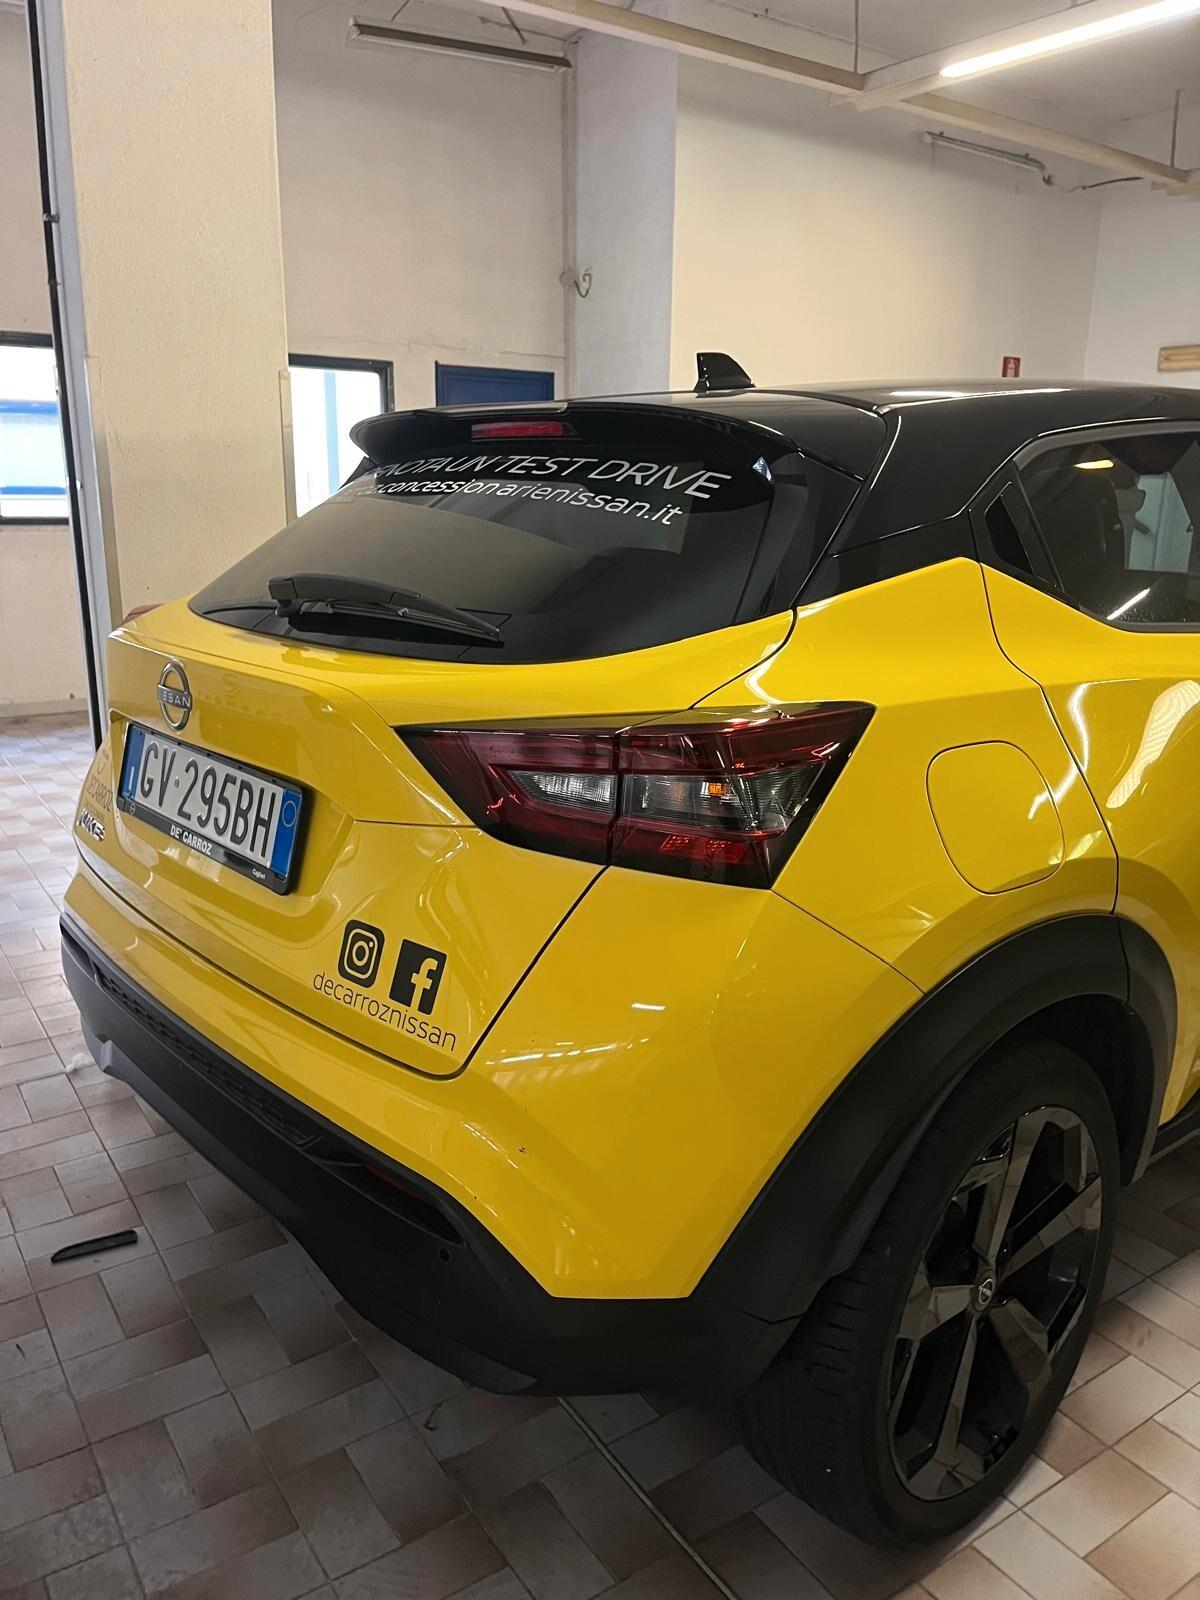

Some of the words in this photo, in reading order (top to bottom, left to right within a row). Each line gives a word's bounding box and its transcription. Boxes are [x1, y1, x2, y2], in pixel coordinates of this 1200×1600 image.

[445, 455, 502, 472] UN
[494, 455, 599, 475] TEST
[587, 460, 732, 499] DRIVE
[140, 742, 176, 807] GV
[177, 759, 276, 858] 295BH
[182, 831, 212, 855] CARROZ
[313, 972, 456, 1052] decarroznissan
